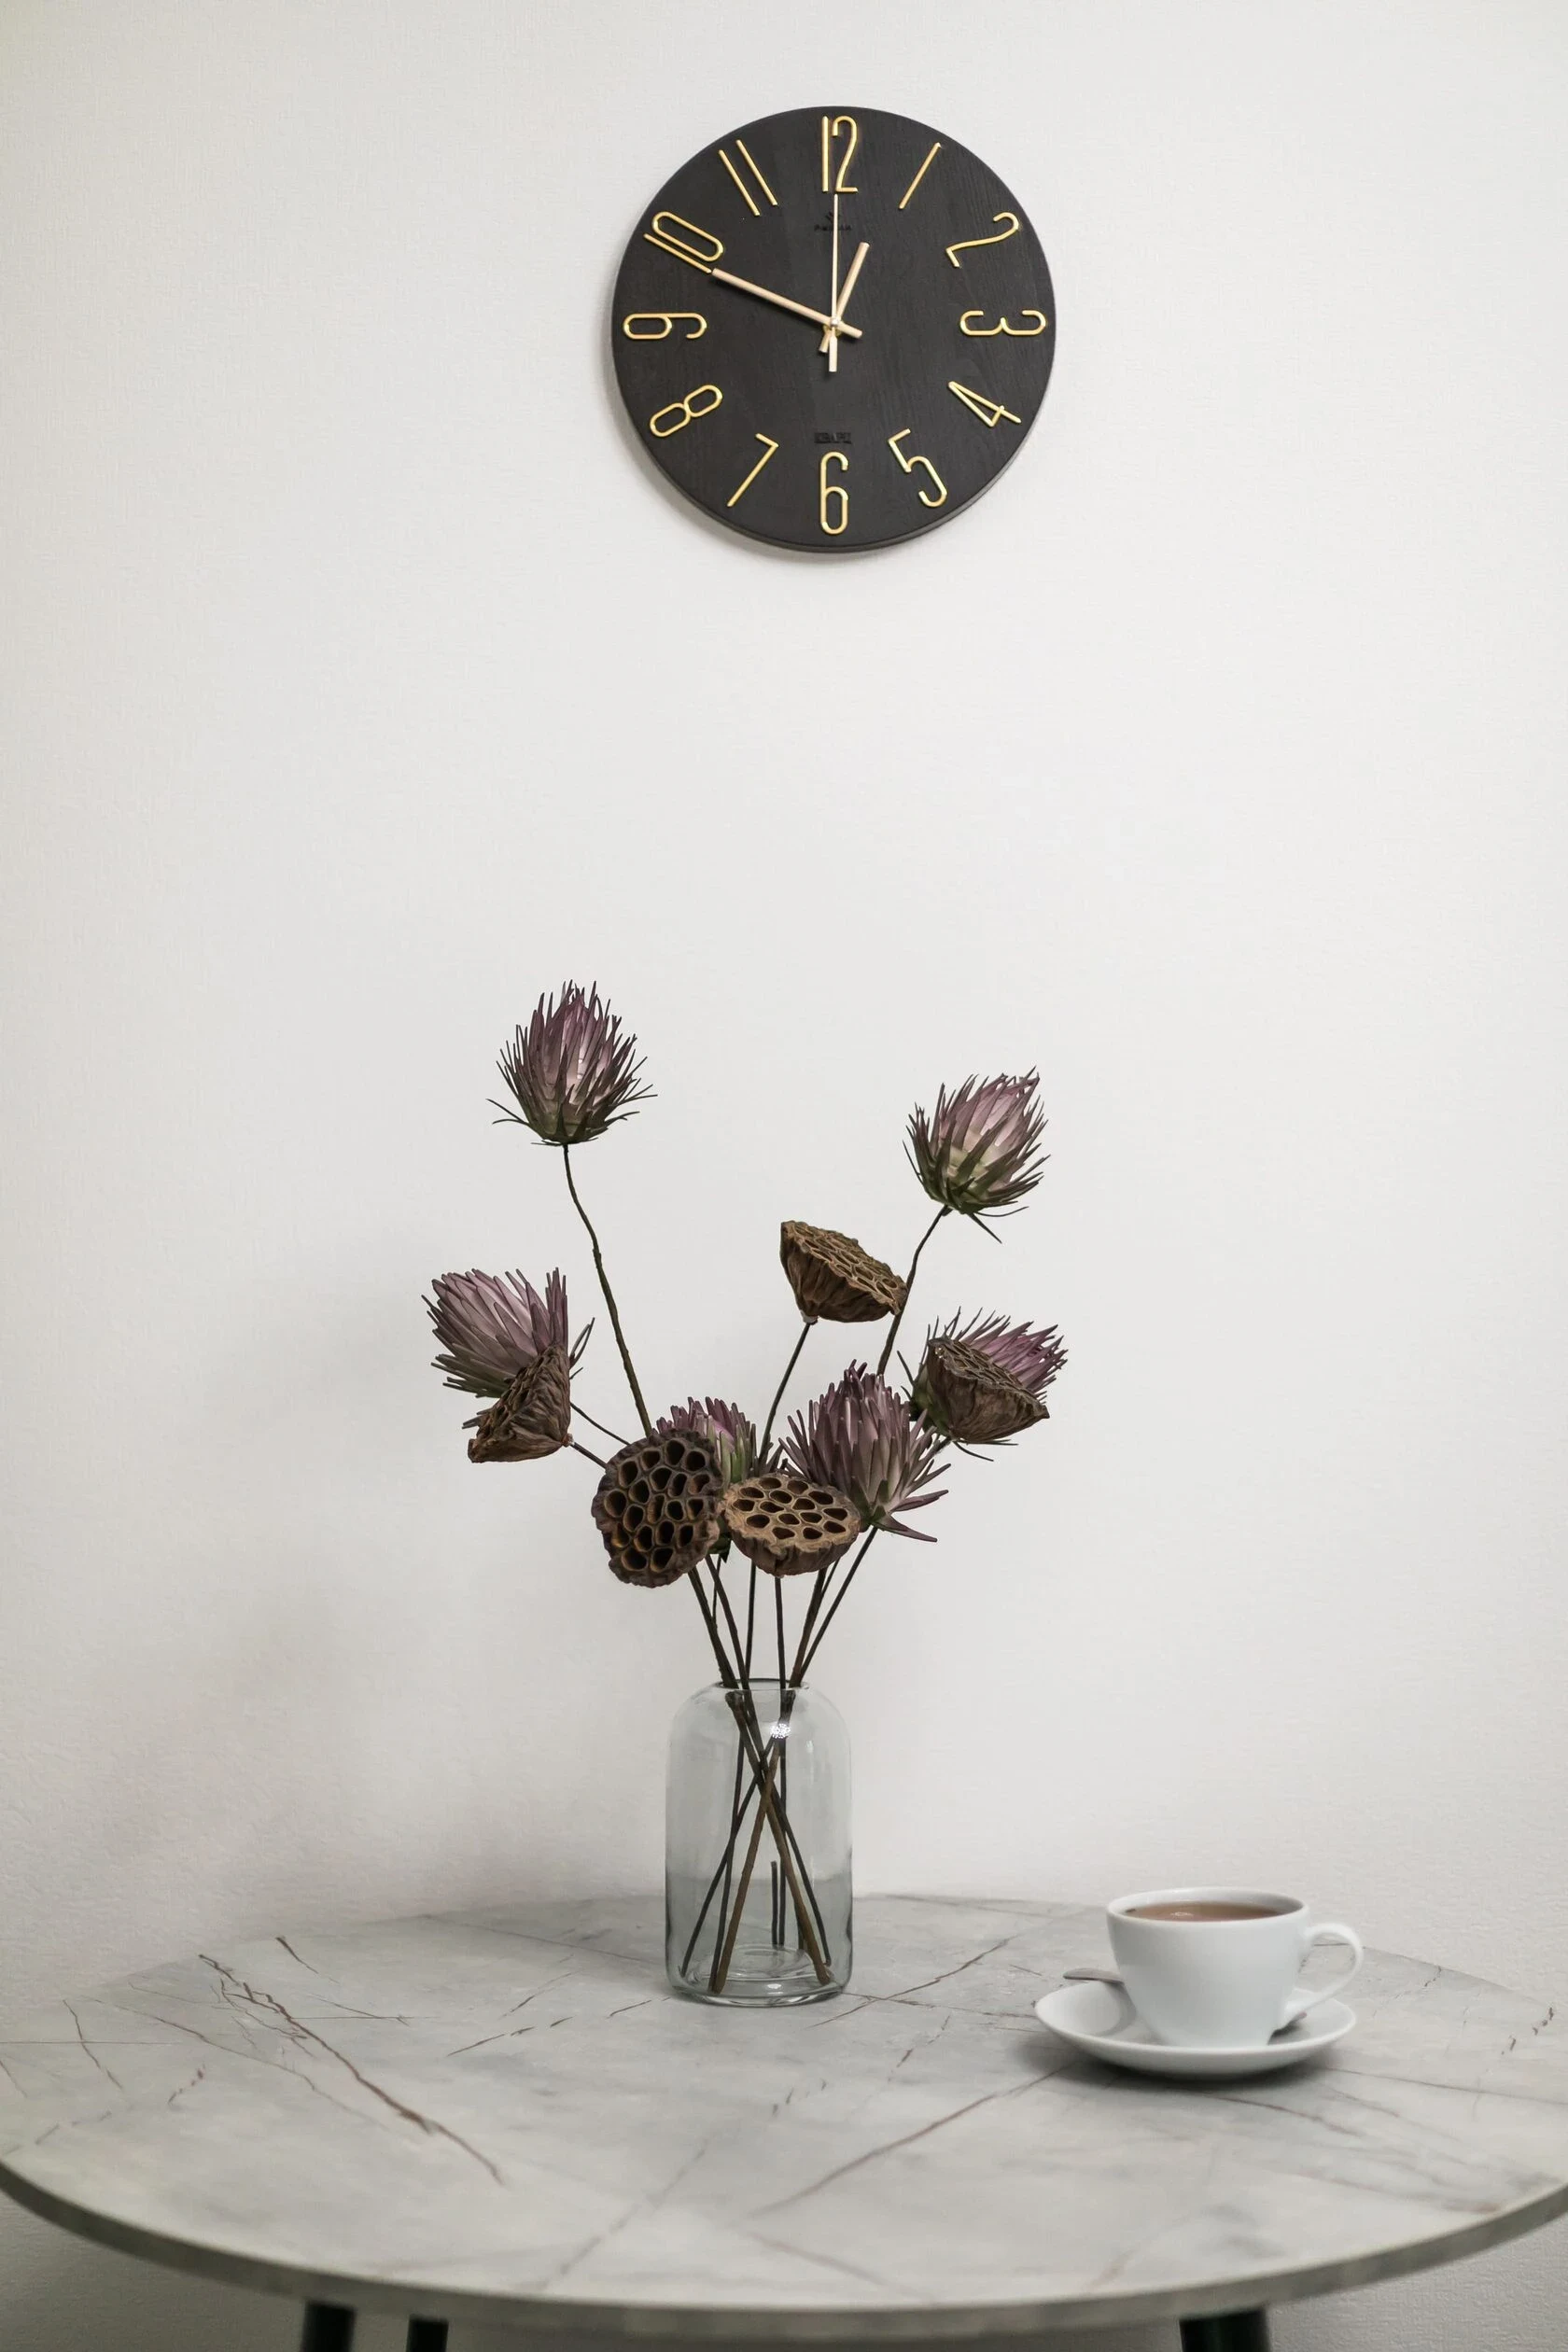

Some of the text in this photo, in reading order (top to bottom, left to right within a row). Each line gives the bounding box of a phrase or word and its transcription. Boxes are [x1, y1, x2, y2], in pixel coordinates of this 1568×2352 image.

[718, 139, 778, 217] 11
[821, 115, 859, 192] 12
[898, 142, 942, 209] 1
[643, 211, 724, 273] 10
[945, 212, 1020, 268] 2
[623, 312, 707, 340] 9
[959, 309, 1047, 336] 3
[650, 384, 723, 438] 8
[947, 380, 1022, 427] 4
[726, 432, 779, 507] 7
[819, 451, 849, 535] 6
[888, 428, 948, 507] 5
